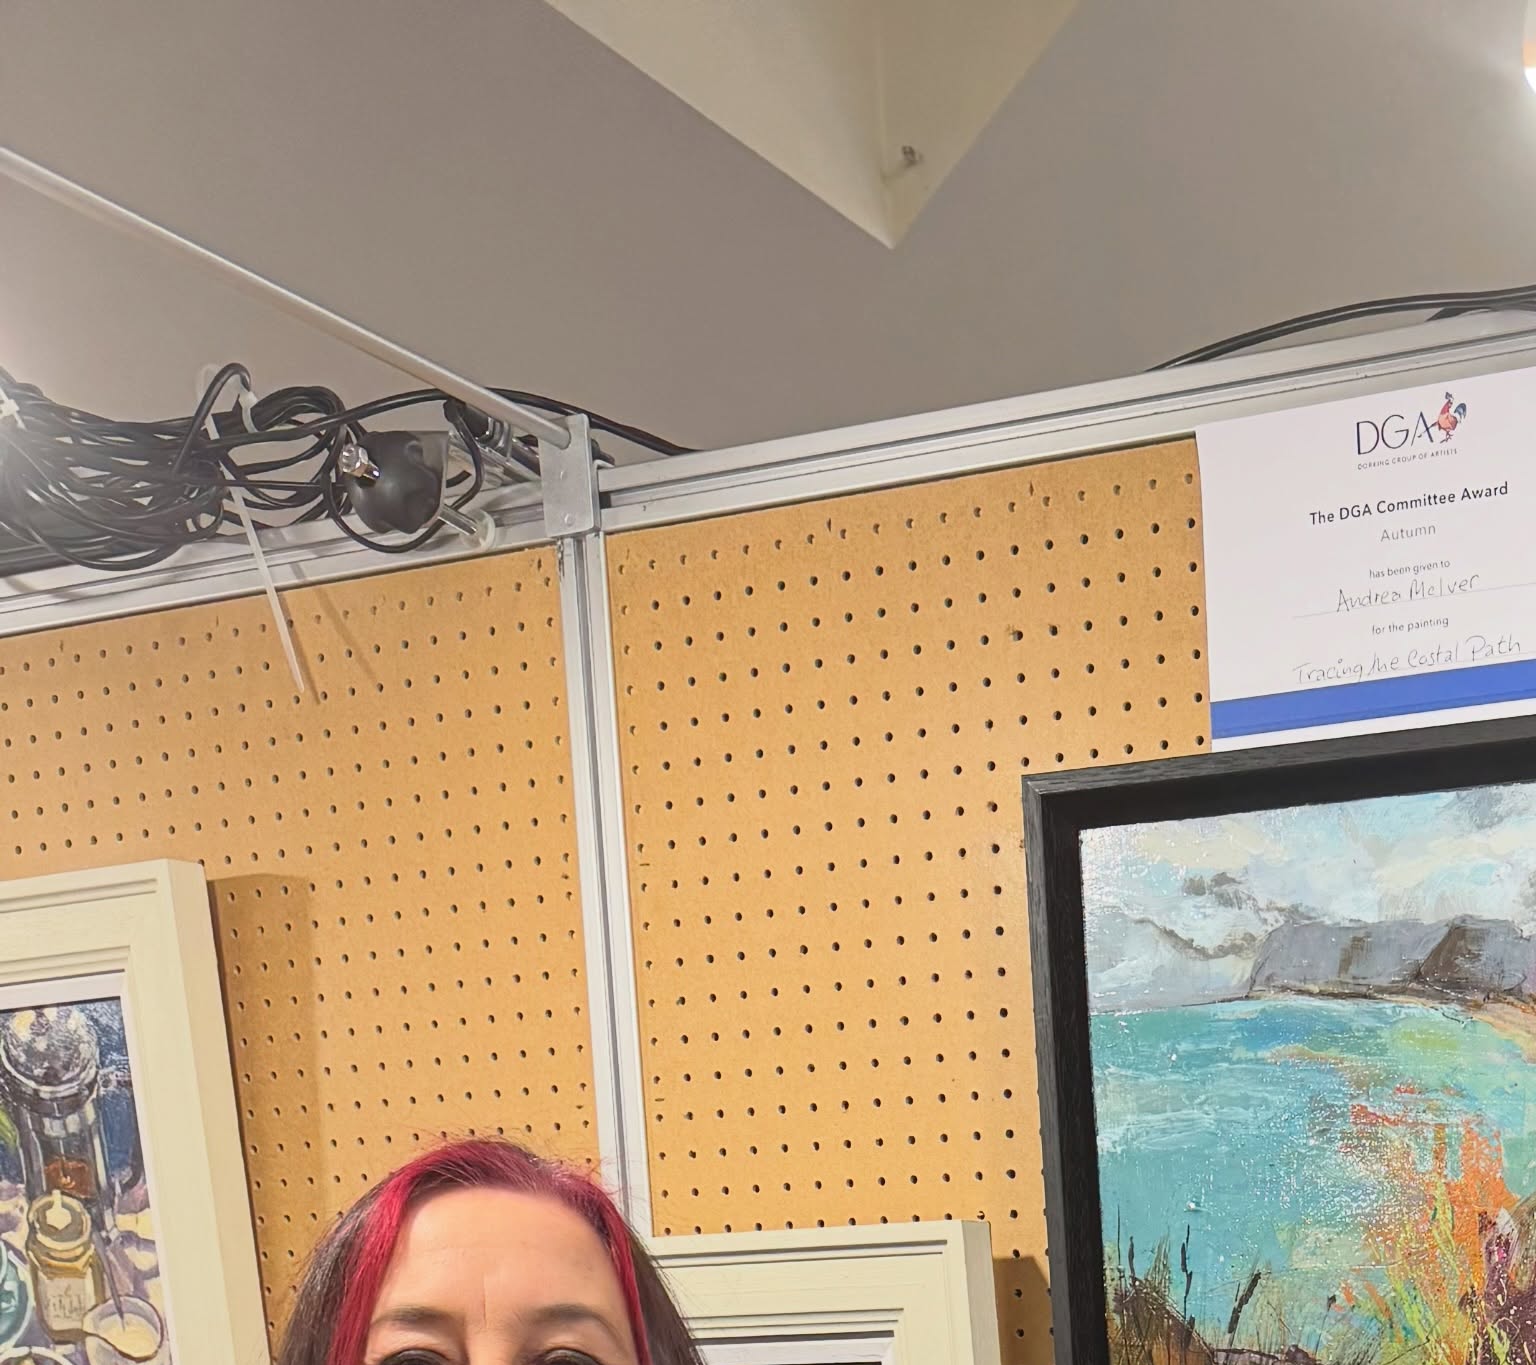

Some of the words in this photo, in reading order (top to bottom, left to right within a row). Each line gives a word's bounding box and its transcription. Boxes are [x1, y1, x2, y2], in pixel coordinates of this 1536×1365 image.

[1357, 411, 1434, 455] DGA
[1419, 452, 1427, 460] OF
[1310, 512, 1334, 525] The
[1340, 504, 1372, 520] DGA
[1377, 493, 1455, 513] Committee
[1461, 481, 1508, 500] Award
[1381, 525, 1436, 542] Autumn
[1370, 568, 1385, 579] has
[1388, 566, 1410, 576] been
[1413, 562, 1438, 575] given
[1441, 560, 1450, 568] to
[1337, 589, 1400, 612] Andrea
[1372, 625, 1385, 635] for
[1389, 624, 1404, 633] the
[1407, 617, 1449, 633] painting
[1293, 658, 1362, 683] Tracing
[1465, 635, 1520, 661] Path
